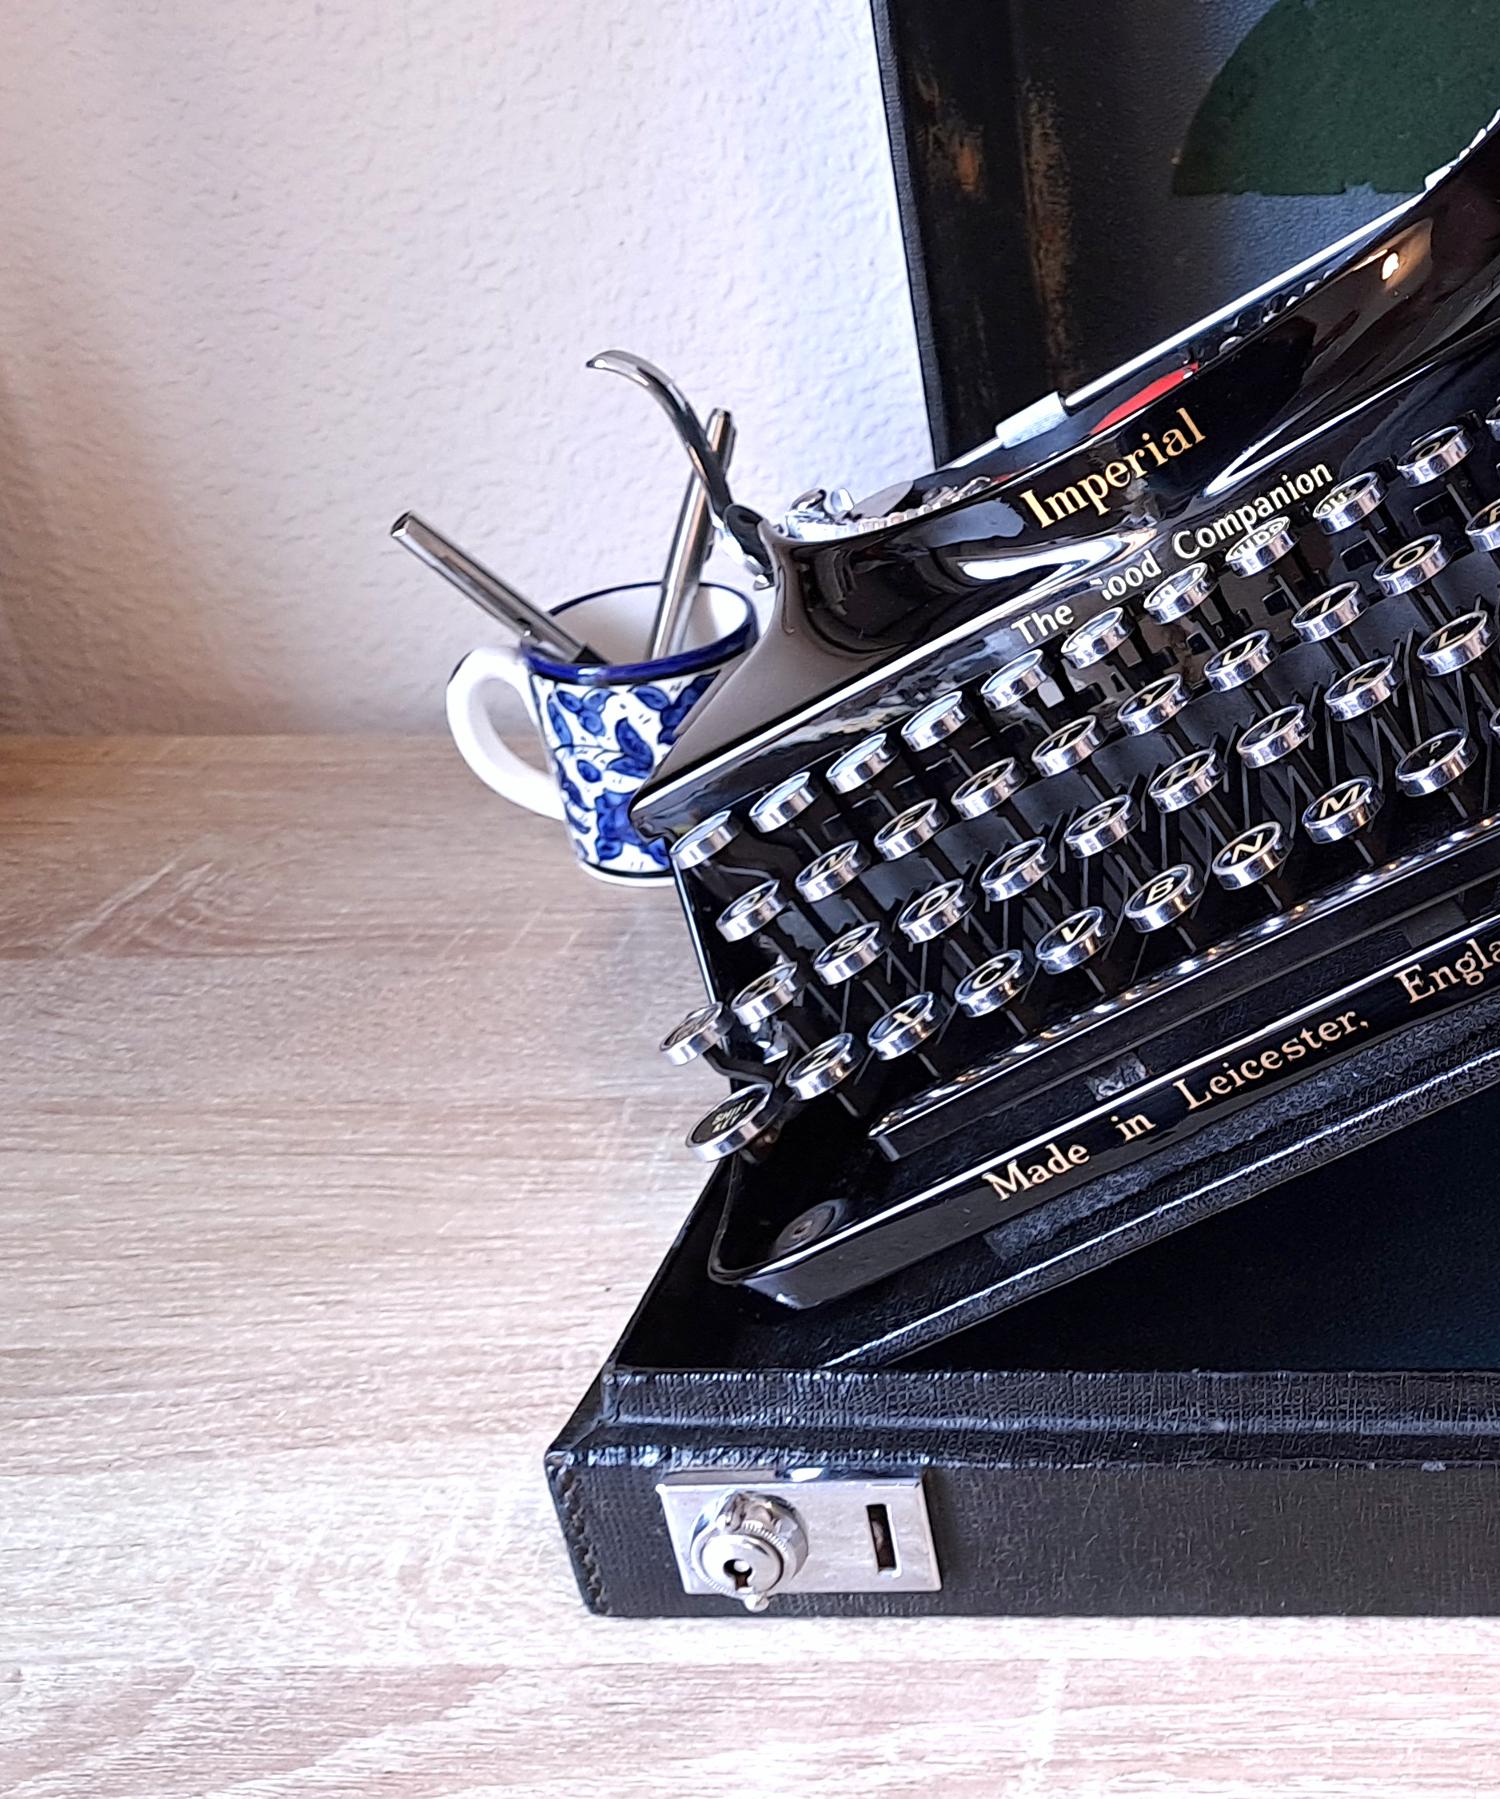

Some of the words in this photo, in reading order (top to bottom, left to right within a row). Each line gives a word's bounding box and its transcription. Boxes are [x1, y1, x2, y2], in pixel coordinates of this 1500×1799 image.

[1019, 407, 1206, 528] Imperial
[1011, 602, 1076, 645] The
[1172, 461, 1333, 560] Companion
[1436, 630, 1465, 650] L
[1318, 784, 1361, 819] M
[1001, 847, 1030, 875] F
[1230, 832, 1265, 865] N
[918, 888, 949, 917] D
[1145, 877, 1174, 905] B
[1060, 917, 1089, 943] V
[972, 962, 1004, 991] C
[981, 1143, 1091, 1202] Made
[1110, 1110, 1157, 1143] in
[1173, 1005, 1370, 1109] Leicester,
